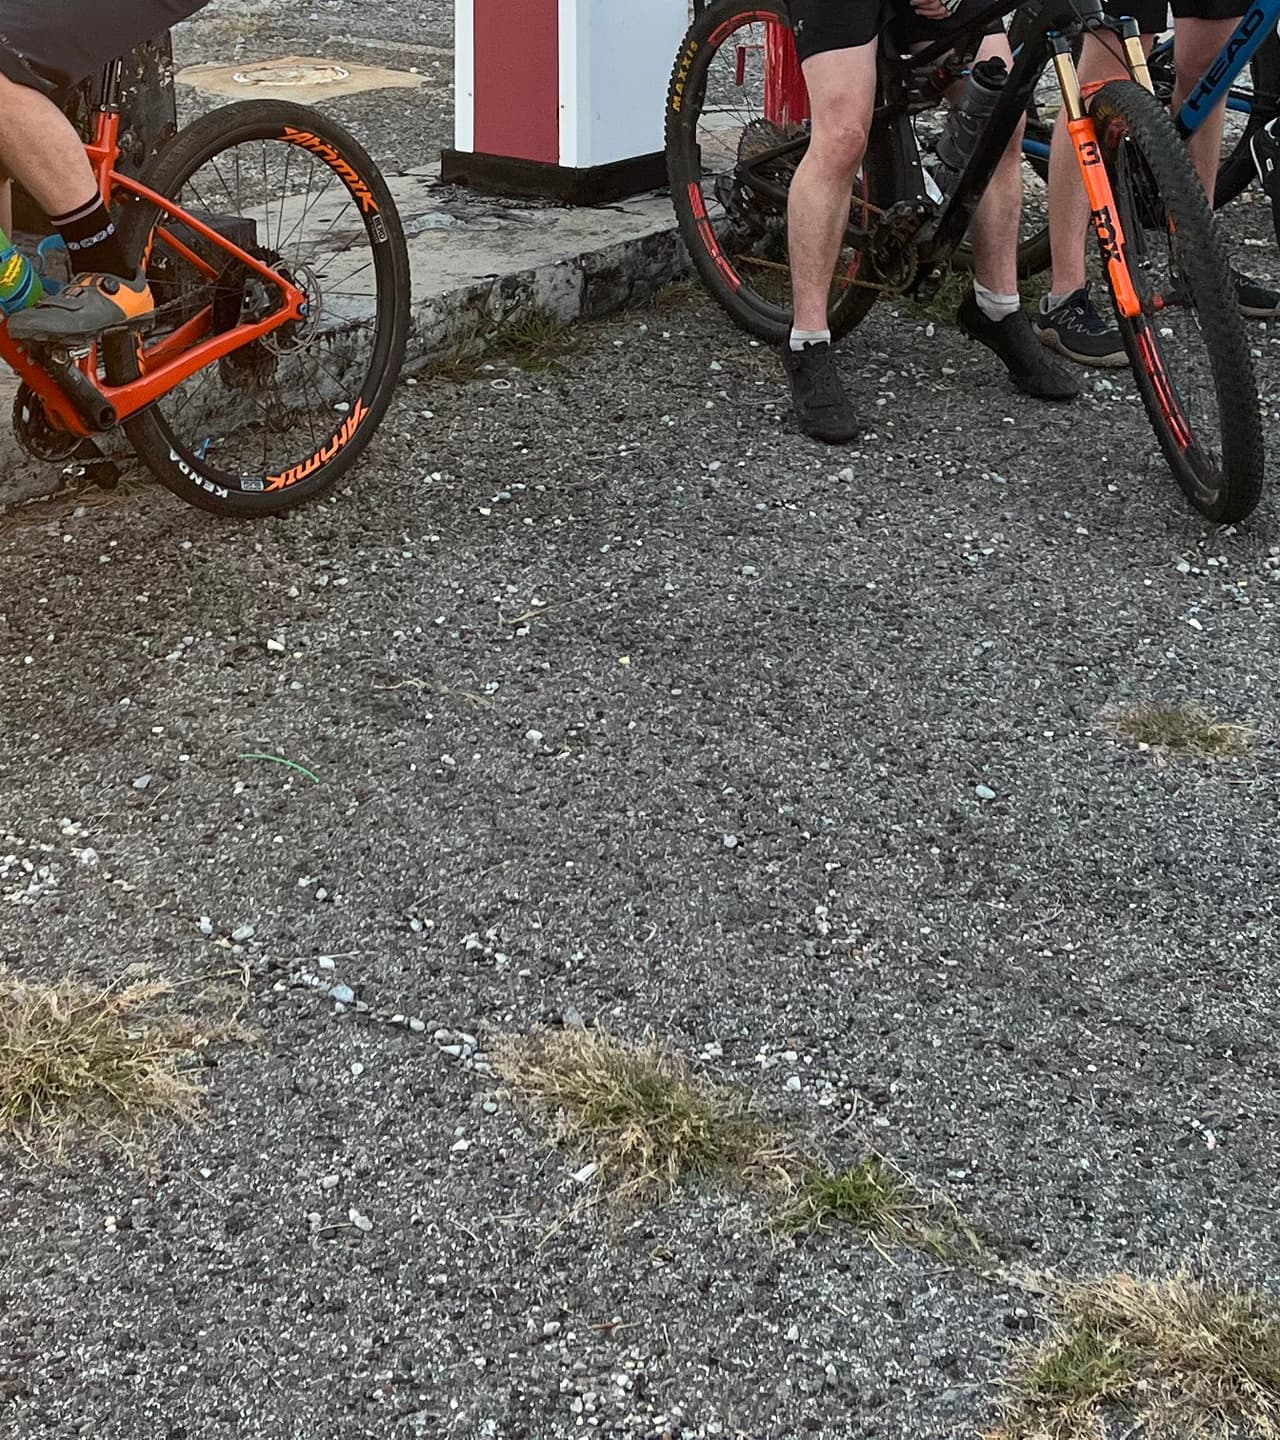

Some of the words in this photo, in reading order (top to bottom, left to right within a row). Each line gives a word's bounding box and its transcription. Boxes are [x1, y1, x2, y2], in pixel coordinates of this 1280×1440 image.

[672, 40, 699, 112] MAXXIS
[1188, 9, 1265, 112] HEAD
[1091, 205, 1122, 263] FOX
[170, 448, 229, 499] KENDA
